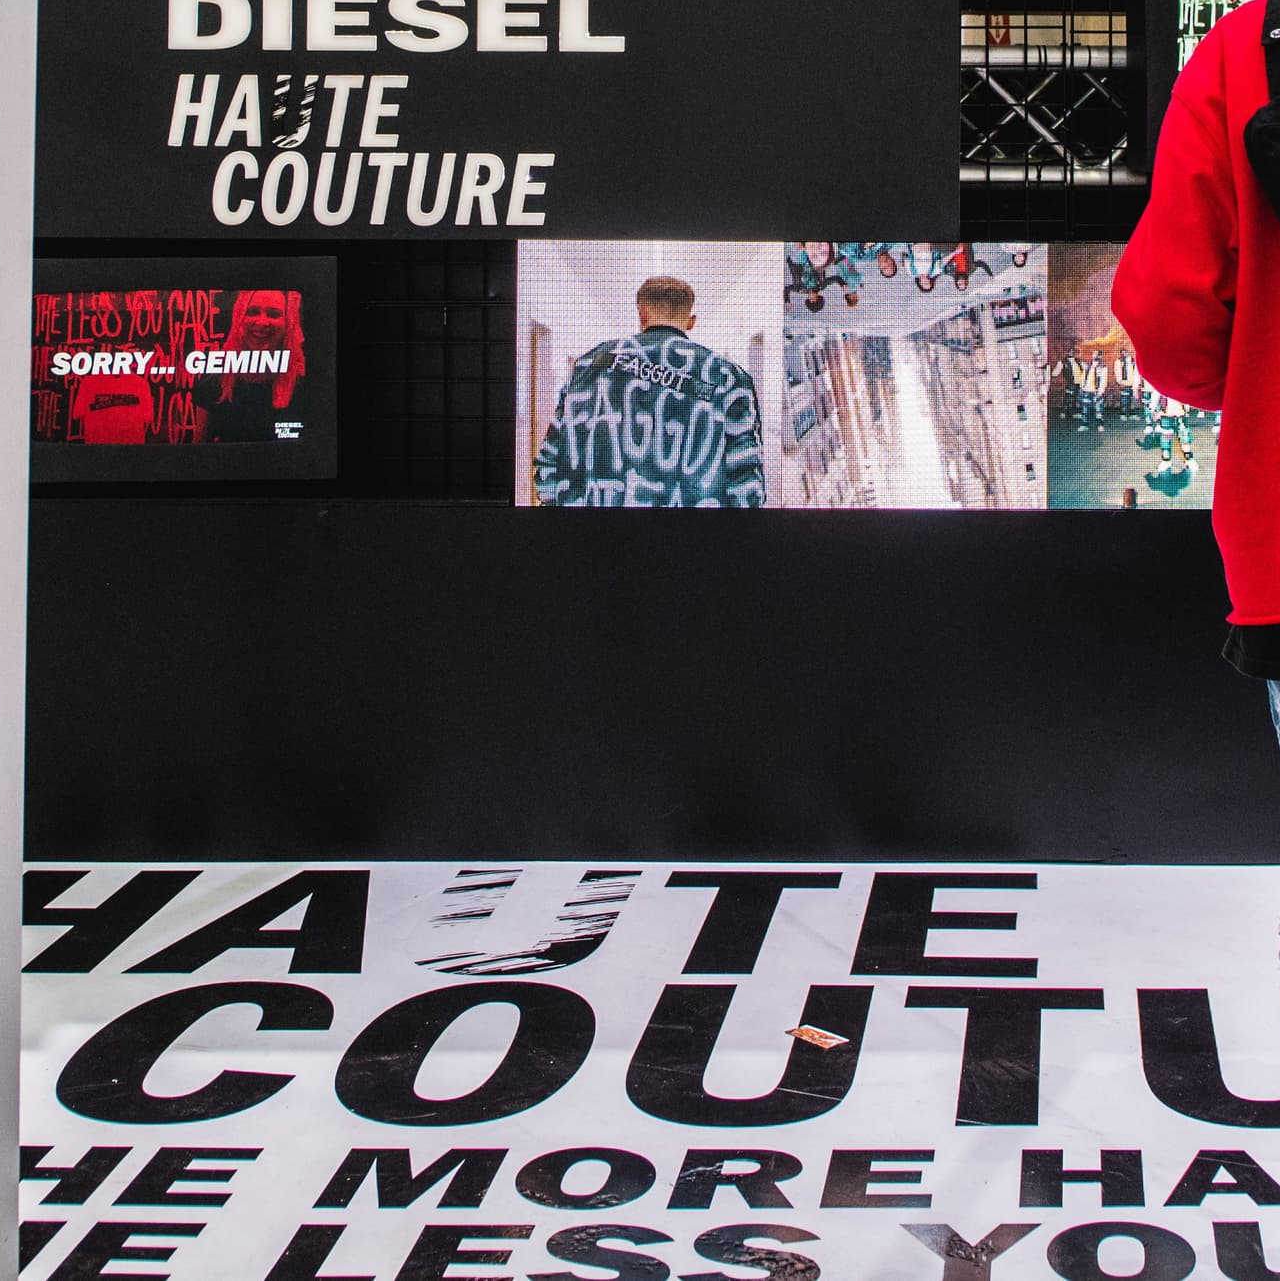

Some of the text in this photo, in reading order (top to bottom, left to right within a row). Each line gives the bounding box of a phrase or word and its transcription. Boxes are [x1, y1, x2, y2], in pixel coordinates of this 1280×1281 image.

[167, 74, 409, 148] HAUTE
[212, 150, 556, 226] COUTURE
[51, 350, 290, 375] SORRY... GEMINI
[610, 354, 693, 391] FAGGOT
[312, 1147, 936, 1210] MORE
[264, 1223, 821, 1281] LESS
